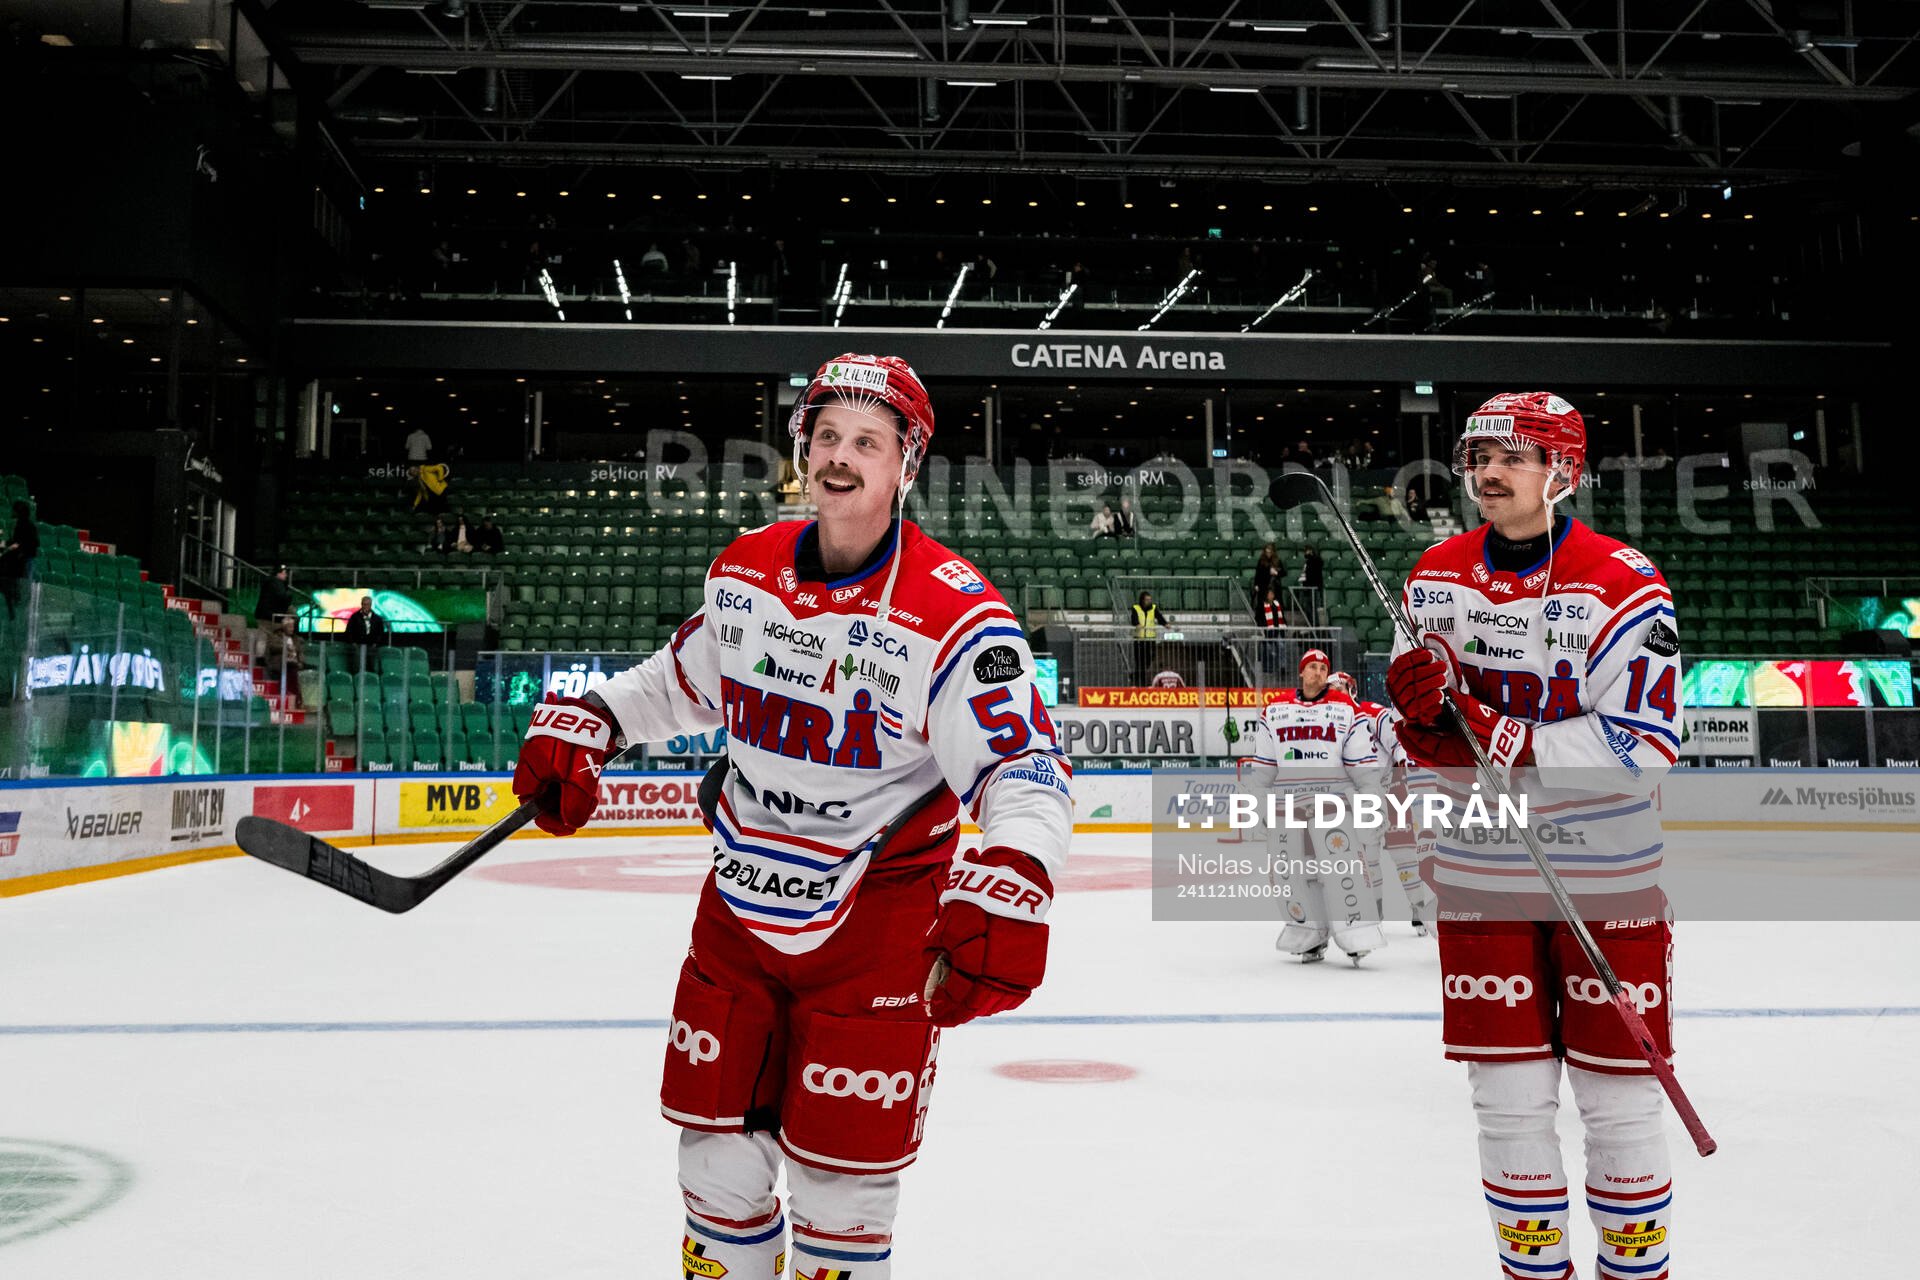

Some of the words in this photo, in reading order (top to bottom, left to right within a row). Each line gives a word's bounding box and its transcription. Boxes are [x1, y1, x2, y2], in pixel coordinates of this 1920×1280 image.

[1010, 342, 1129, 370] CATENA
[1136, 344, 1226, 371] Arena
[843, 367, 886, 386] LILIUM
[1479, 417, 1512, 432] LILIUM
[368, 462, 413, 480] sekti
[590, 465, 648, 481] sektion
[655, 465, 677, 480] RV
[1077, 471, 1135, 487] sektion
[1138, 471, 1165, 486] RM
[646, 428, 1352, 542] BRNNBORN
[1393, 446, 1824, 541] CTER
[1579, 473, 1601, 488] RH
[1742, 475, 1802, 491] sektion
[1802, 476, 1816, 490] M
[1420, 569, 1461, 580] BAUER
[1489, 580, 1514, 595] SHL
[1562, 582, 1607, 595] BAUER
[166, 599, 189, 610] MAXI
[723, 591, 752, 614] SCA
[793, 592, 819, 609] SHL
[1428, 591, 1454, 604] SCA
[868, 600, 924, 626] BUER
[1467, 609, 1529, 630] HIGHCON
[1424, 616, 1455, 632] LILIUM
[720, 623, 744, 646] ILIUM
[763, 620, 826, 652] HIGHCON
[1559, 631, 1590, 650] LILIU
[871, 631, 909, 662] SCA
[1488, 646, 1525, 660] NHC
[776, 666, 817, 688] NHC
[819, 658, 838, 694] A
[859, 657, 901, 696] LILIUM
[252, 683, 265, 693] AXI
[1460, 658, 1582, 723] MRÅ
[1625, 655, 1678, 724] 14
[1109, 691, 1241, 706] FLAGGFABRKEN
[271, 711, 293, 723] MXI
[532, 709, 603, 739] UER
[967, 681, 1058, 757] 54
[1693, 717, 1749, 733] STÄDAX
[1276, 722, 1337, 743] TIMRÅ
[1693, 734, 1750, 743] Fnsterputs
[1303, 751, 1329, 760] NHC
[1674, 759, 1691, 767] ozt
[1827, 758, 1859, 767] Boozt
[1886, 758, 1919, 767] Boozt
[368, 761, 393, 772] Boozt
[413, 761, 438, 771] Boozt
[656, 760, 686, 770] Boozt
[1000, 768, 1055, 787] UNDSVALLS
[598, 782, 702, 806] LYTGOL
[1184, 779, 1238, 794] Tomm
[426, 785, 481, 811] MVB
[1796, 787, 1916, 810] Myresjöhus
[171, 789, 210, 830] IMPACT
[210, 788, 226, 826] BY
[690, 808, 703, 819] A
[79, 811, 143, 839] BAUER
[1442, 823, 1587, 846] BILBOLGET
[713, 845, 841, 901] LBOLAGET
[944, 869, 1044, 915] AUER
[1438, 910, 1483, 922] BAUER
[1603, 915, 1657, 932] BAUER
[1444, 974, 1534, 1008] coop
[872, 992, 919, 1008] BAUE
[667, 1014, 720, 1066] op
[802, 1063, 915, 1110] coop
[1510, 1173, 1552, 1182] BAUER
[1612, 1174, 1655, 1184] BAUER
[1502, 1227, 1557, 1243] SUNDFRAKT
[1605, 1230, 1662, 1246] SUNDFRAKT
[683, 1255, 714, 1273] FRAKT
